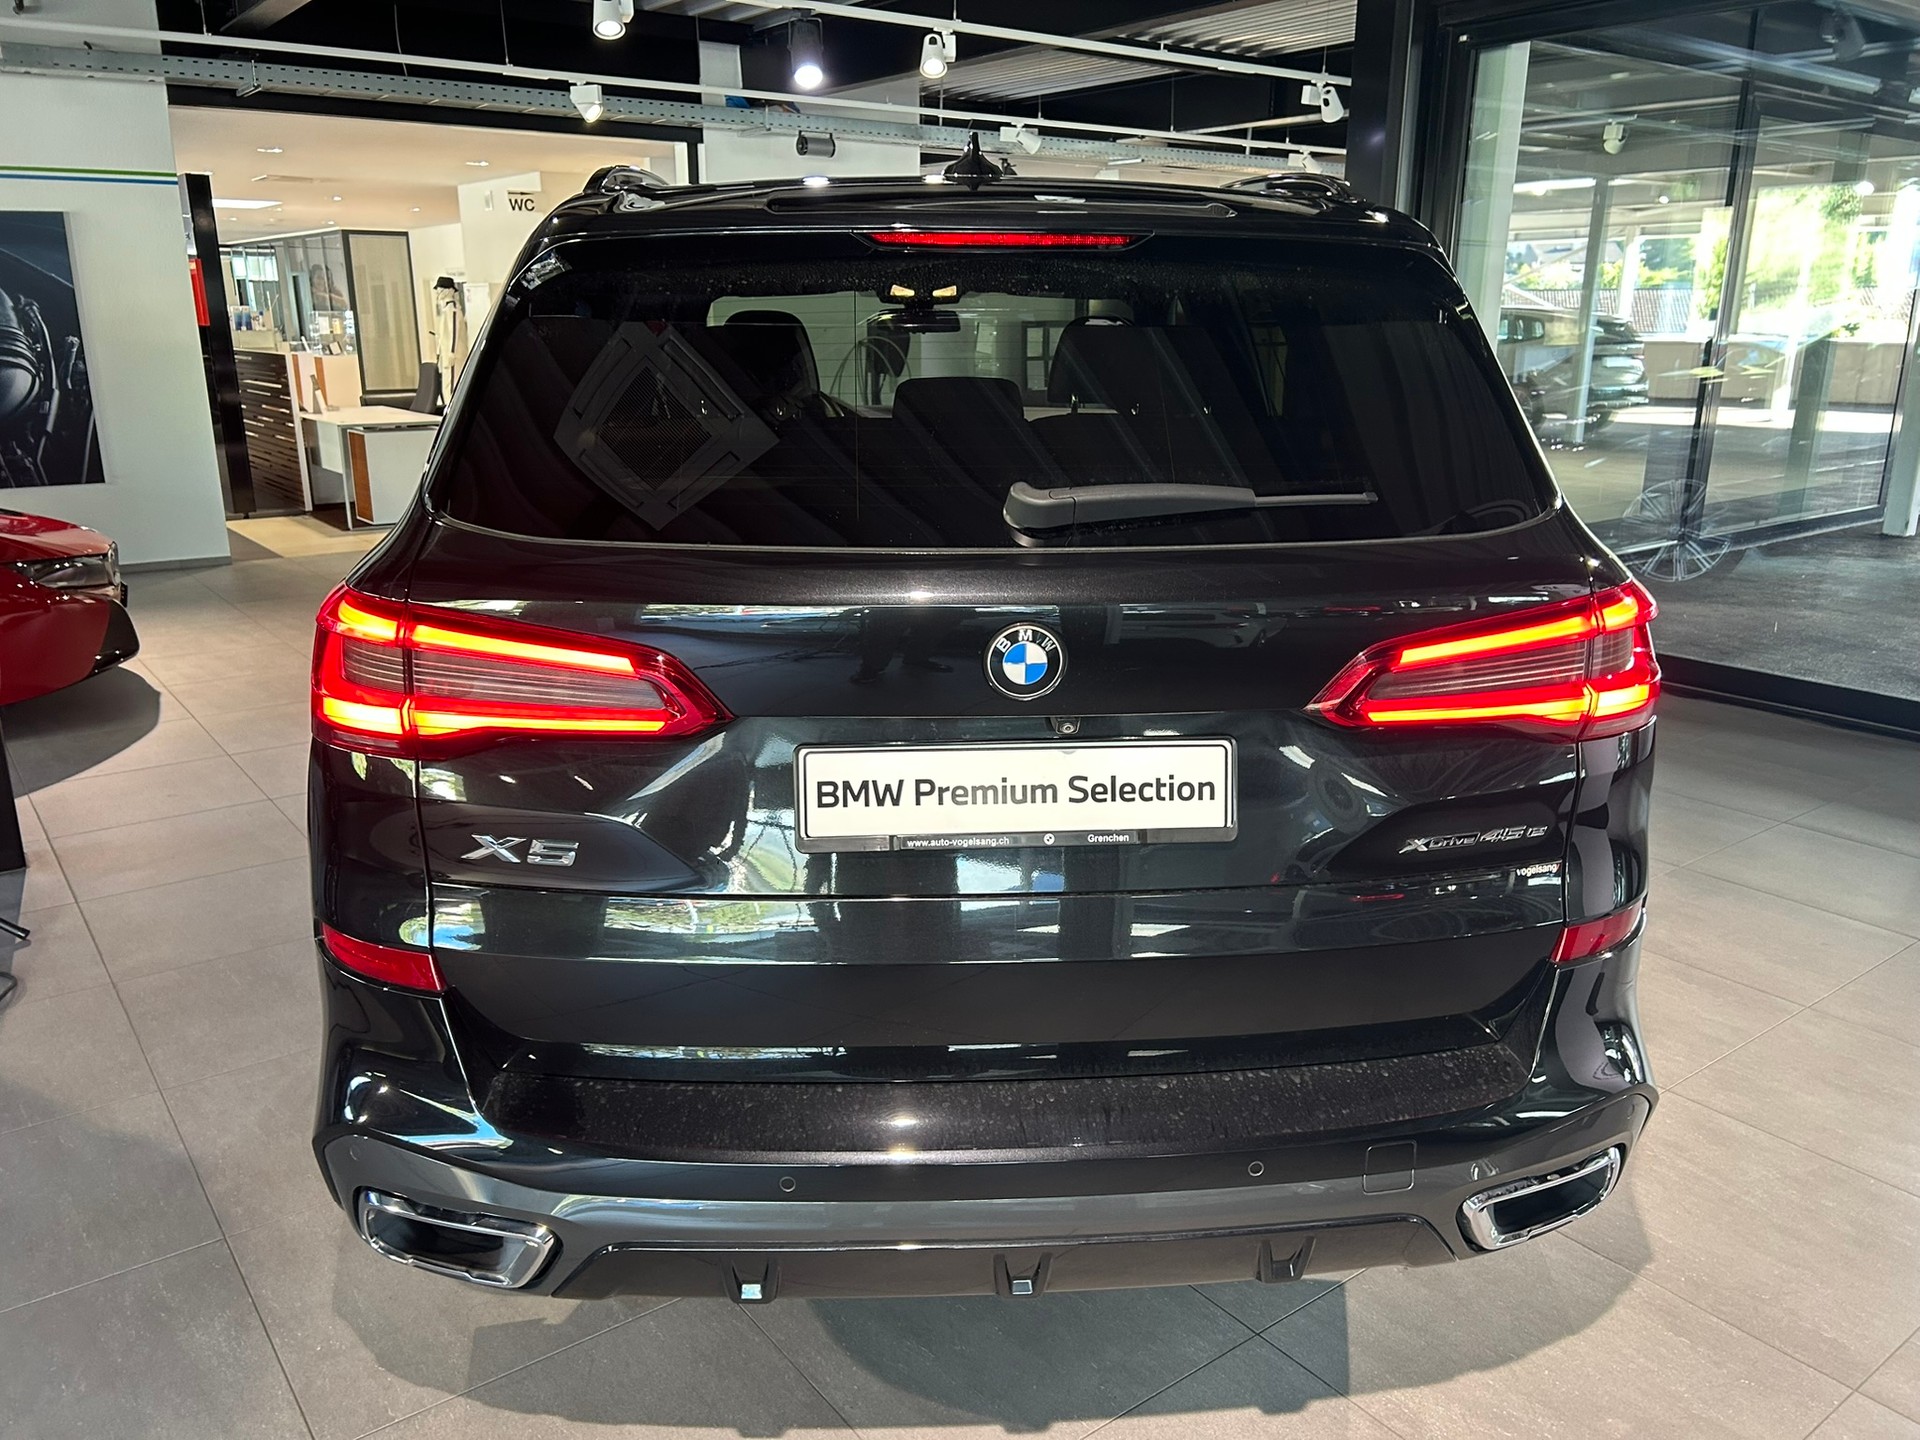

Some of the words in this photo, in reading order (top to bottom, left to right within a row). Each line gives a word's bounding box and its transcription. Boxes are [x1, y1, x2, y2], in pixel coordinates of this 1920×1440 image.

[508, 198, 535, 212] WC
[996, 628, 1056, 653] BMW
[816, 778, 904, 808] BMW
[914, 776, 1058, 806] Premium
[1068, 774, 1216, 804] Selection
[460, 833, 580, 867] X5
[906, 836, 1010, 848] www.auto-vogelsang.ch
[1087, 833, 1130, 843] Grenchen
[1516, 863, 1558, 877] vogelsang
